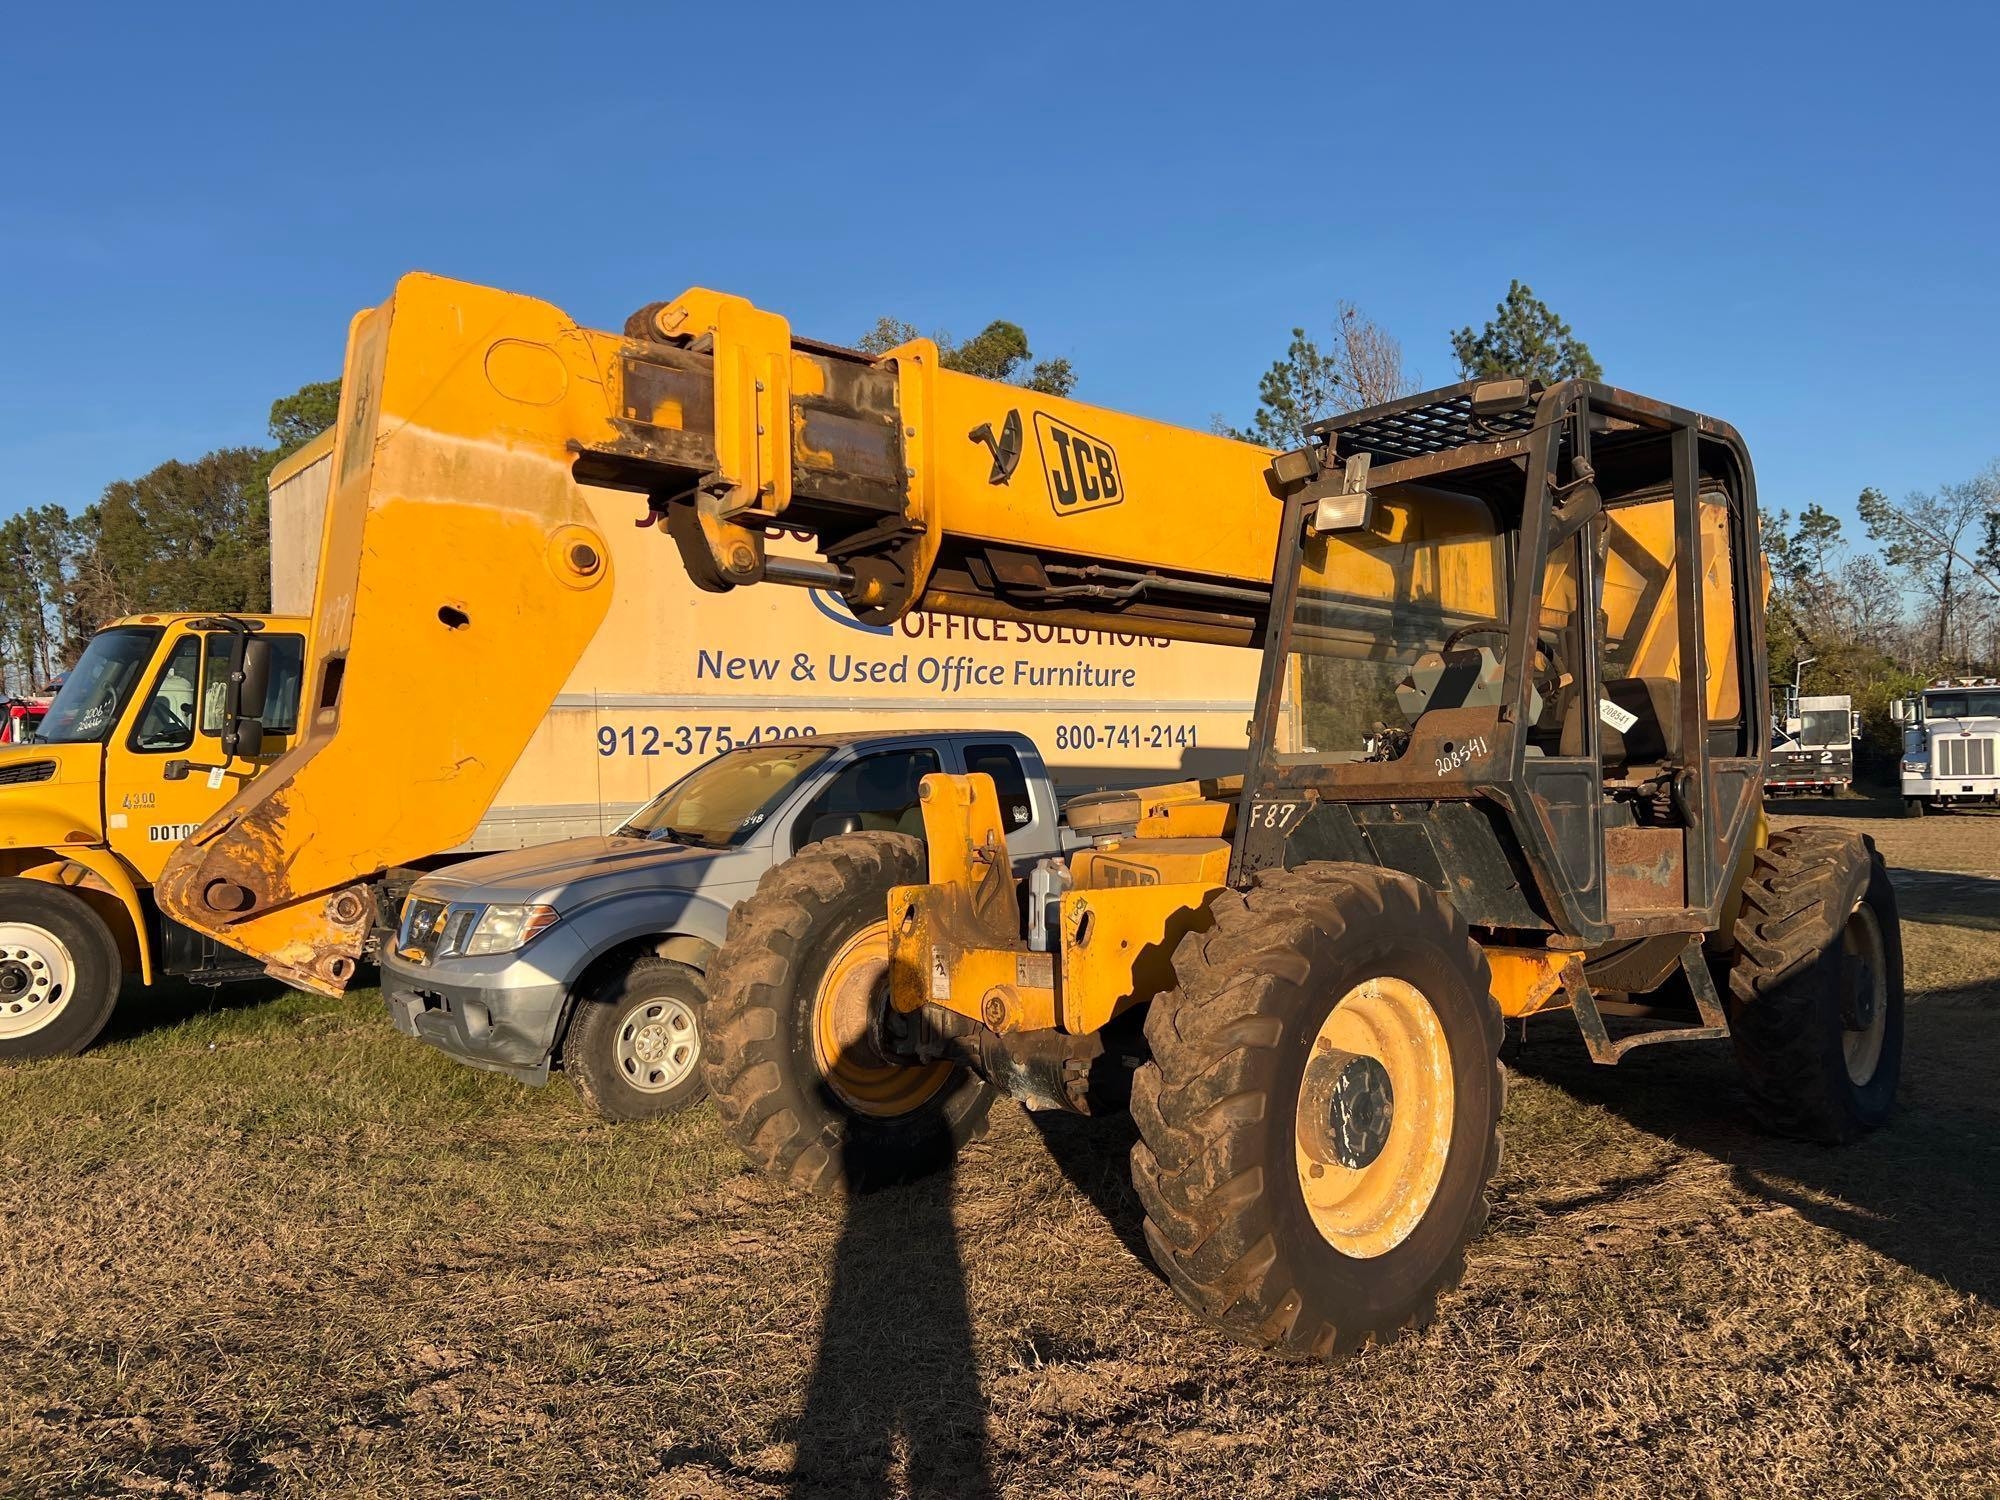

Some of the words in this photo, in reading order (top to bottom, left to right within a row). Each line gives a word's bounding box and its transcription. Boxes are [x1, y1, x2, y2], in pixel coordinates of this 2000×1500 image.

[1051, 426, 1117, 505] JCB
[901, 611, 1008, 642] OFFICE
[697, 649, 781, 680] New
[790, 652, 816, 681] &
[829, 654, 907, 683] Used
[917, 655, 1004, 692] Office
[1013, 660, 1136, 687] Furniture
[1602, 705, 1630, 724] 208541
[1056, 724, 1198, 750] 800-741-2141
[1434, 736, 1488, 777] 208541
[1821, 750, 1833, 764] 2
[123, 792, 155, 809] 4300
